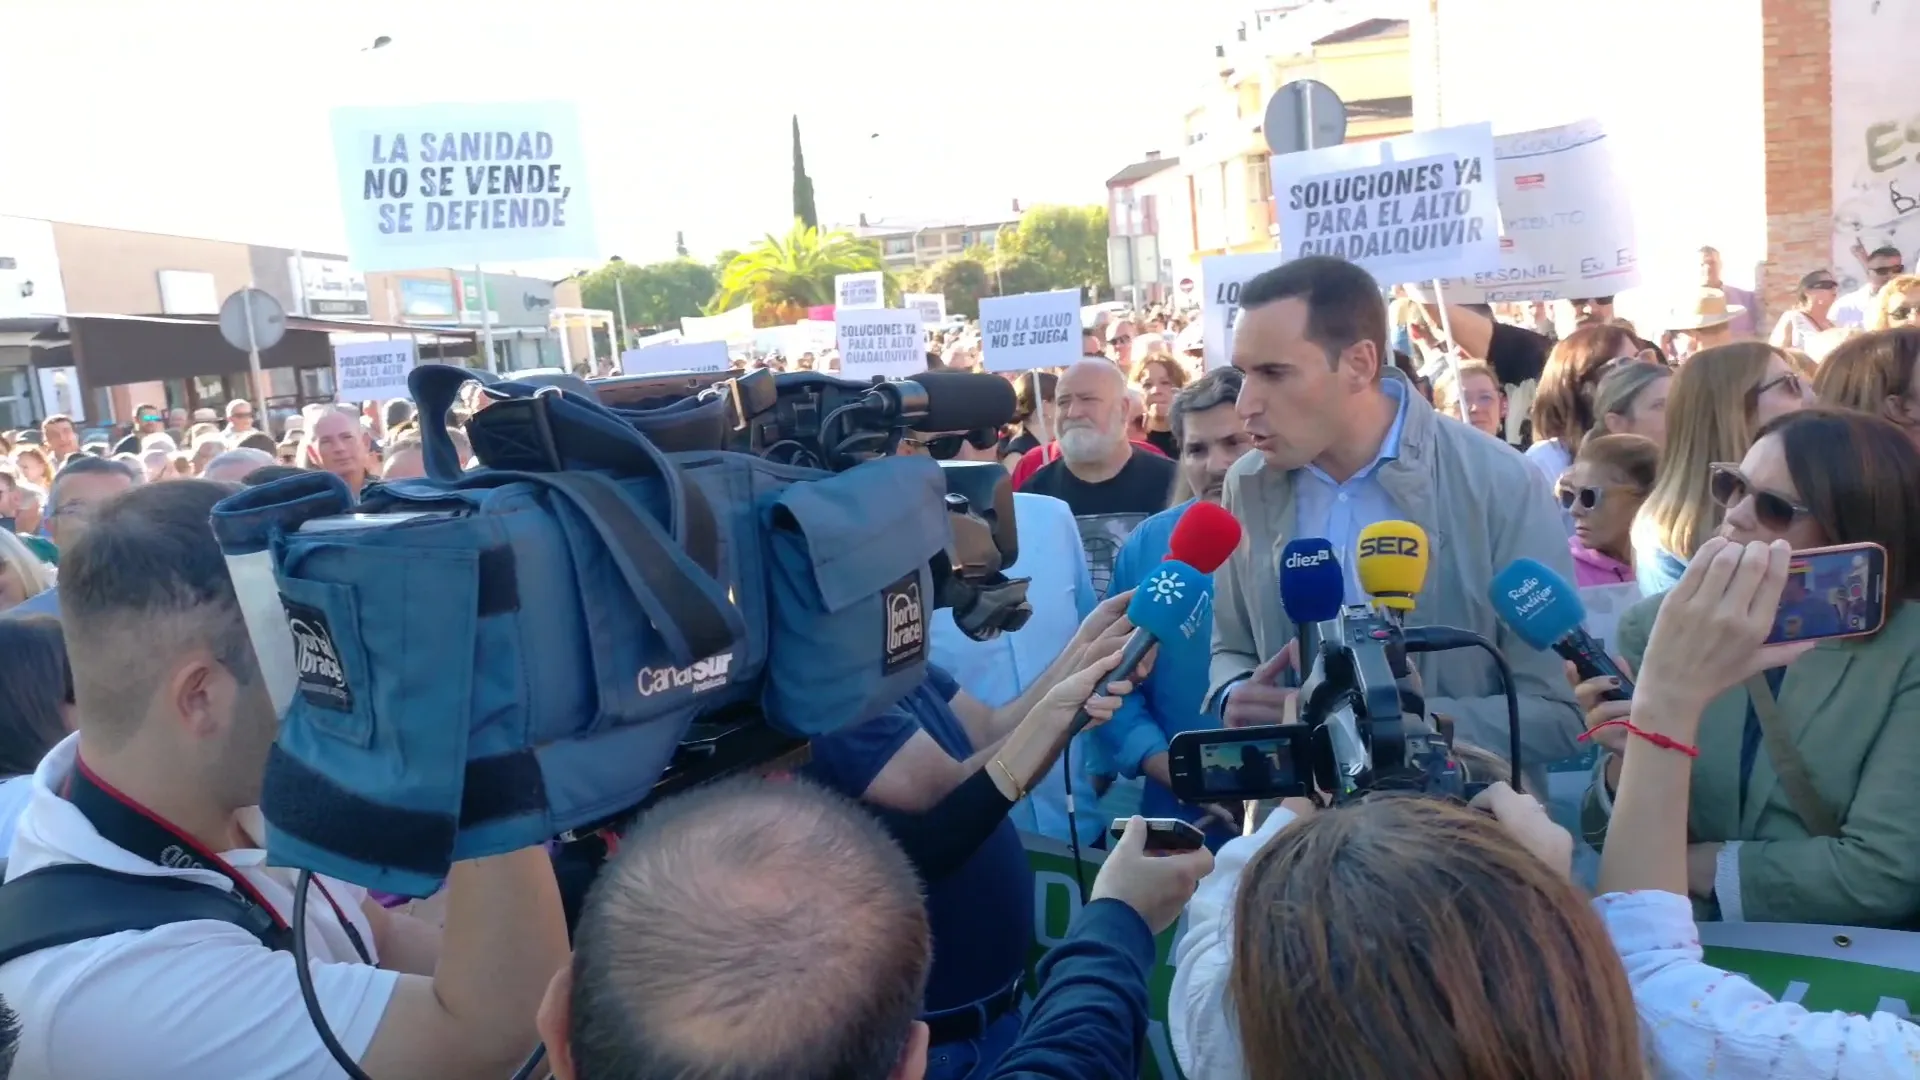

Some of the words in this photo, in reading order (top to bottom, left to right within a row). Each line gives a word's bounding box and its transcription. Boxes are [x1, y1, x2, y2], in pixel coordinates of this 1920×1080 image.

[372, 133, 409, 164] LA
[420, 131, 553, 162] SANIDAD
[364, 167, 408, 200] NO
[420, 166, 454, 197] SE
[465, 164, 571, 198] VENDE,
[1290, 163, 1443, 210] SOLUCIONES
[1453, 157, 1482, 186] YA
[378, 202, 414, 234] SE
[425, 198, 566, 231] DEFIENDE
[1305, 205, 1368, 237] PARA
[1378, 201, 1403, 227] EL
[1411, 189, 1472, 224] ALTO
[841, 323, 902, 337] SOLUCIONES
[904, 323, 916, 335] YA
[986, 319, 1011, 334] CON
[1015, 317, 1029, 331] LA
[1033, 312, 1072, 330] SALUD
[848, 338, 874, 350] PARA
[877, 338, 887, 349] EL
[891, 337, 913, 349] ALTO
[991, 334, 1009, 348] NO
[1011, 332, 1026, 347] SE
[1029, 329, 1068, 345] JUEGA
[1360, 536, 1419, 557] SER
[1286, 552, 1320, 568] diez
[1508, 577, 1539, 601] Radio
[891, 623, 920, 650] brace
